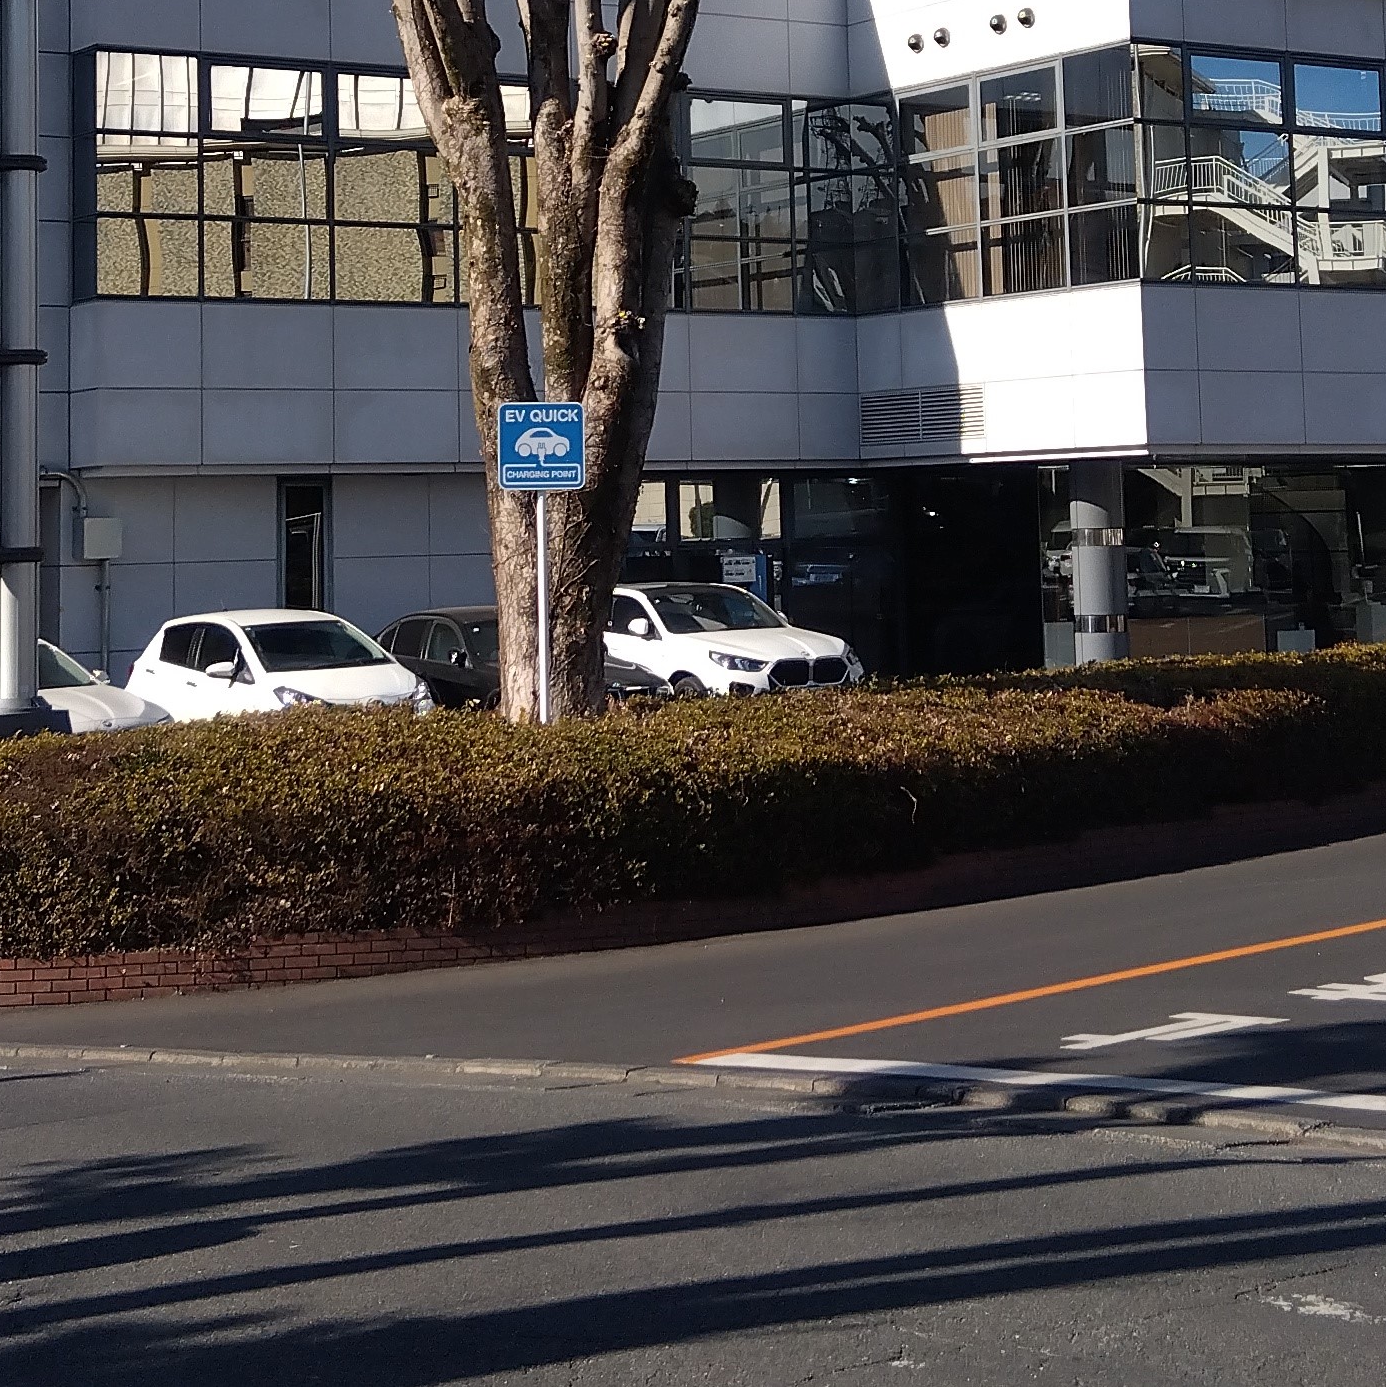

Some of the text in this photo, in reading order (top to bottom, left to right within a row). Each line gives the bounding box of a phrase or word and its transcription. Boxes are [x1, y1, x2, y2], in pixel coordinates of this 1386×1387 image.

[505, 409, 579, 423] EV QUICK
[507, 470, 577, 479] CHARGING POINT
